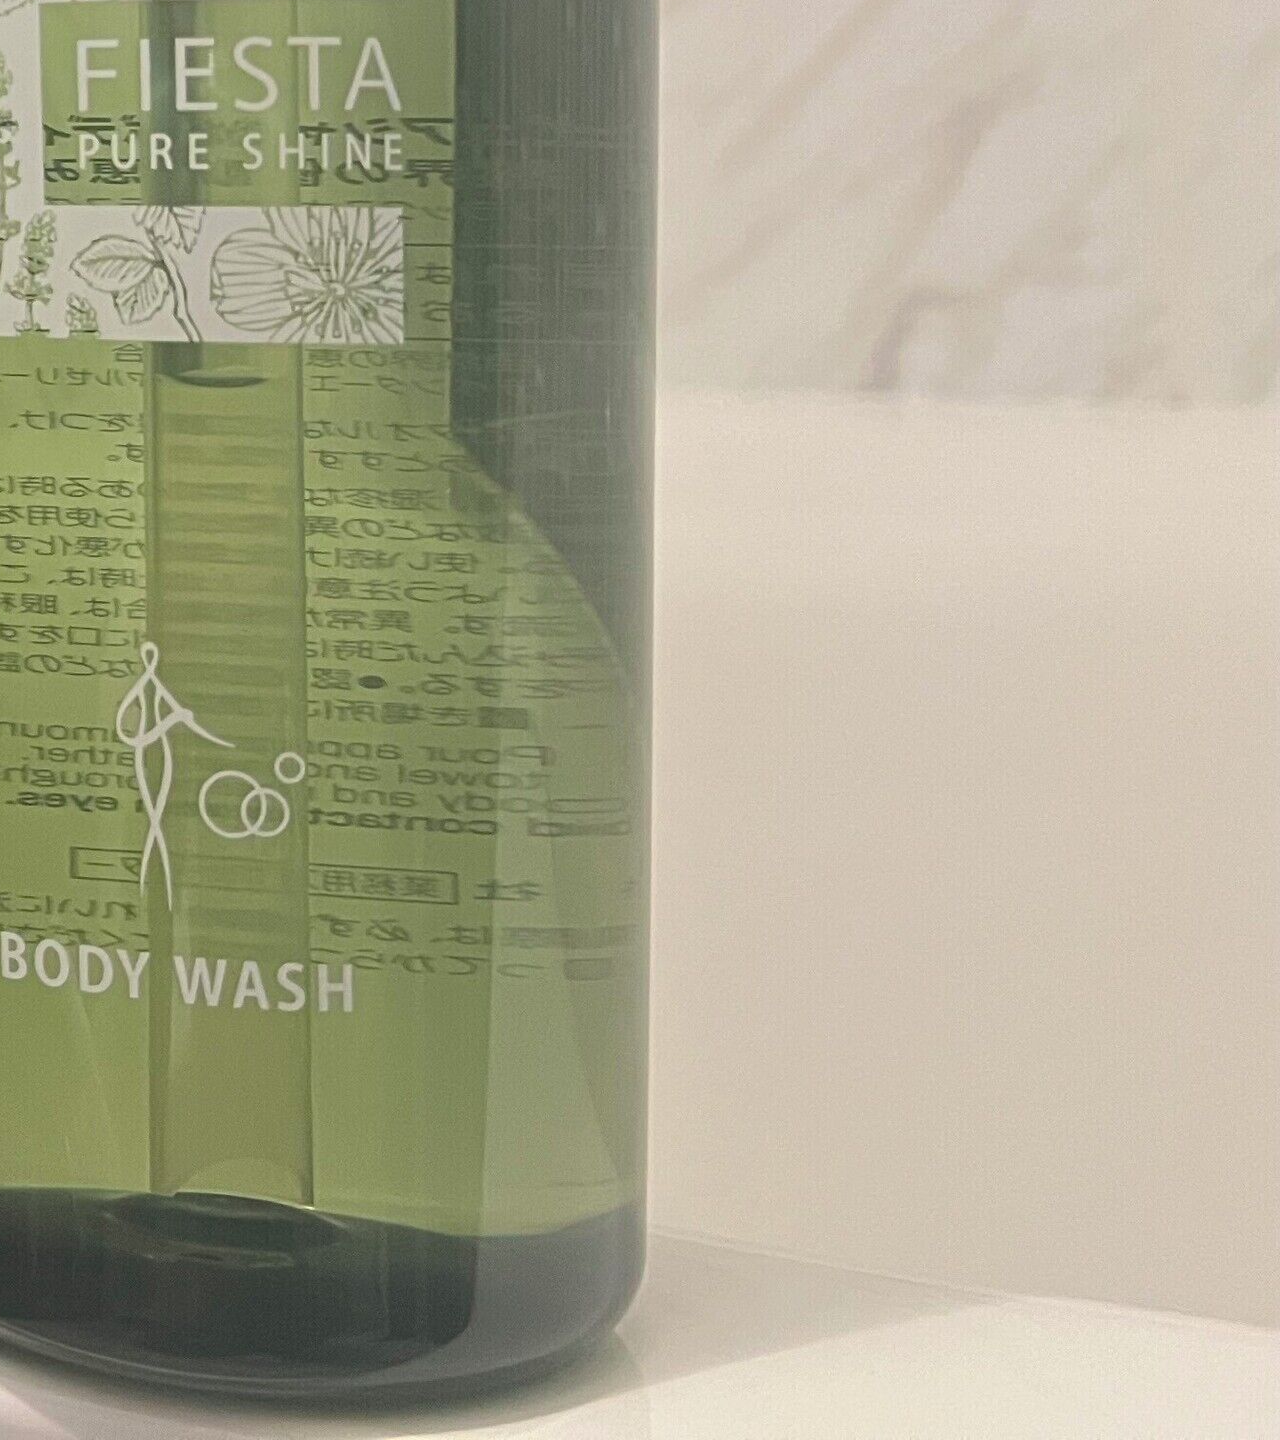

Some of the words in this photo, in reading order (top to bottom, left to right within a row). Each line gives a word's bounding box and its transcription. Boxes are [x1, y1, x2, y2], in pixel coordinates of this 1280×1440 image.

[76, 36, 401, 112] FIESTA
[79, 134, 211, 170] PURE
[243, 133, 404, 170] SHINE
[0, 931, 148, 998] BODY
[173, 955, 355, 1012] WASH
